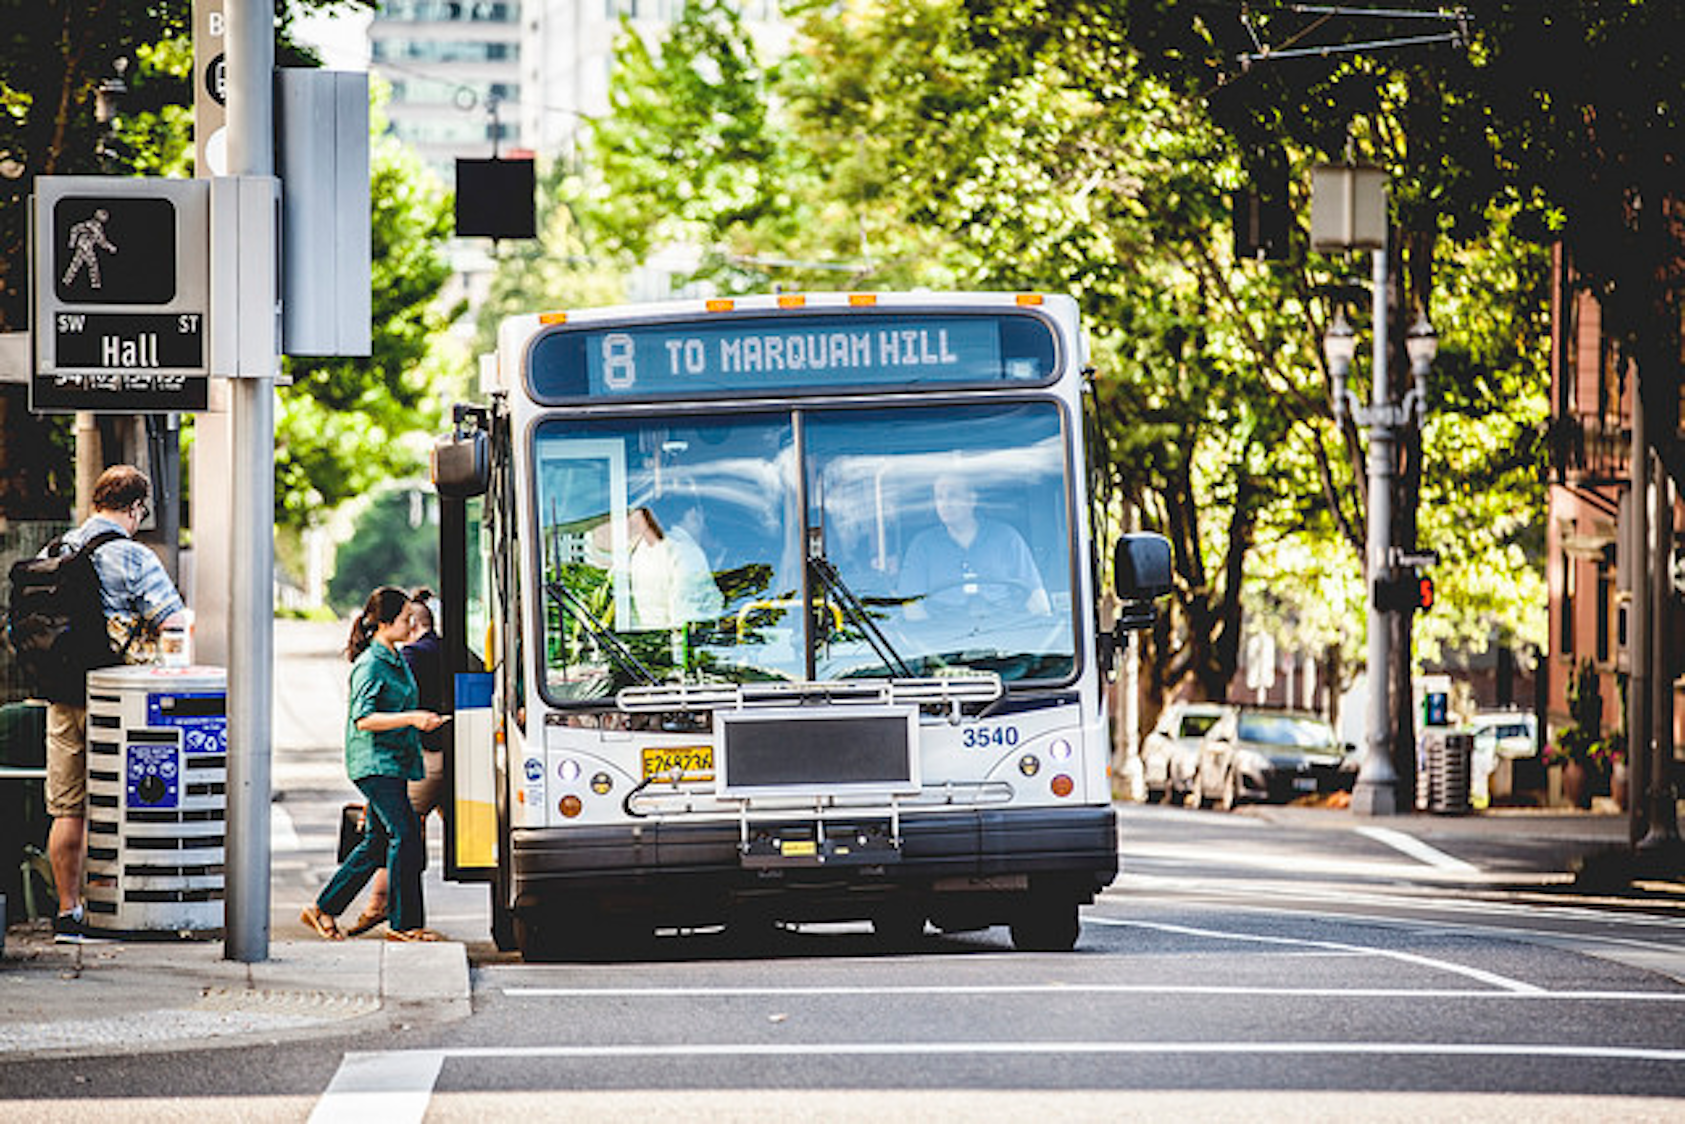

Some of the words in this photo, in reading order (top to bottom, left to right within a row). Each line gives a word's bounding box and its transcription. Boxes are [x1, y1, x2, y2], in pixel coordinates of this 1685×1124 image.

[57, 314, 86, 333] SW
[178, 314, 199, 333] ST
[102, 333, 159, 367] Hall
[602, 333, 635, 390] 8
[665, 338, 704, 375] TO
[720, 332, 871, 372] MARQUAM
[879, 329, 957, 365] HILL
[963, 726, 1019, 748] 3540
